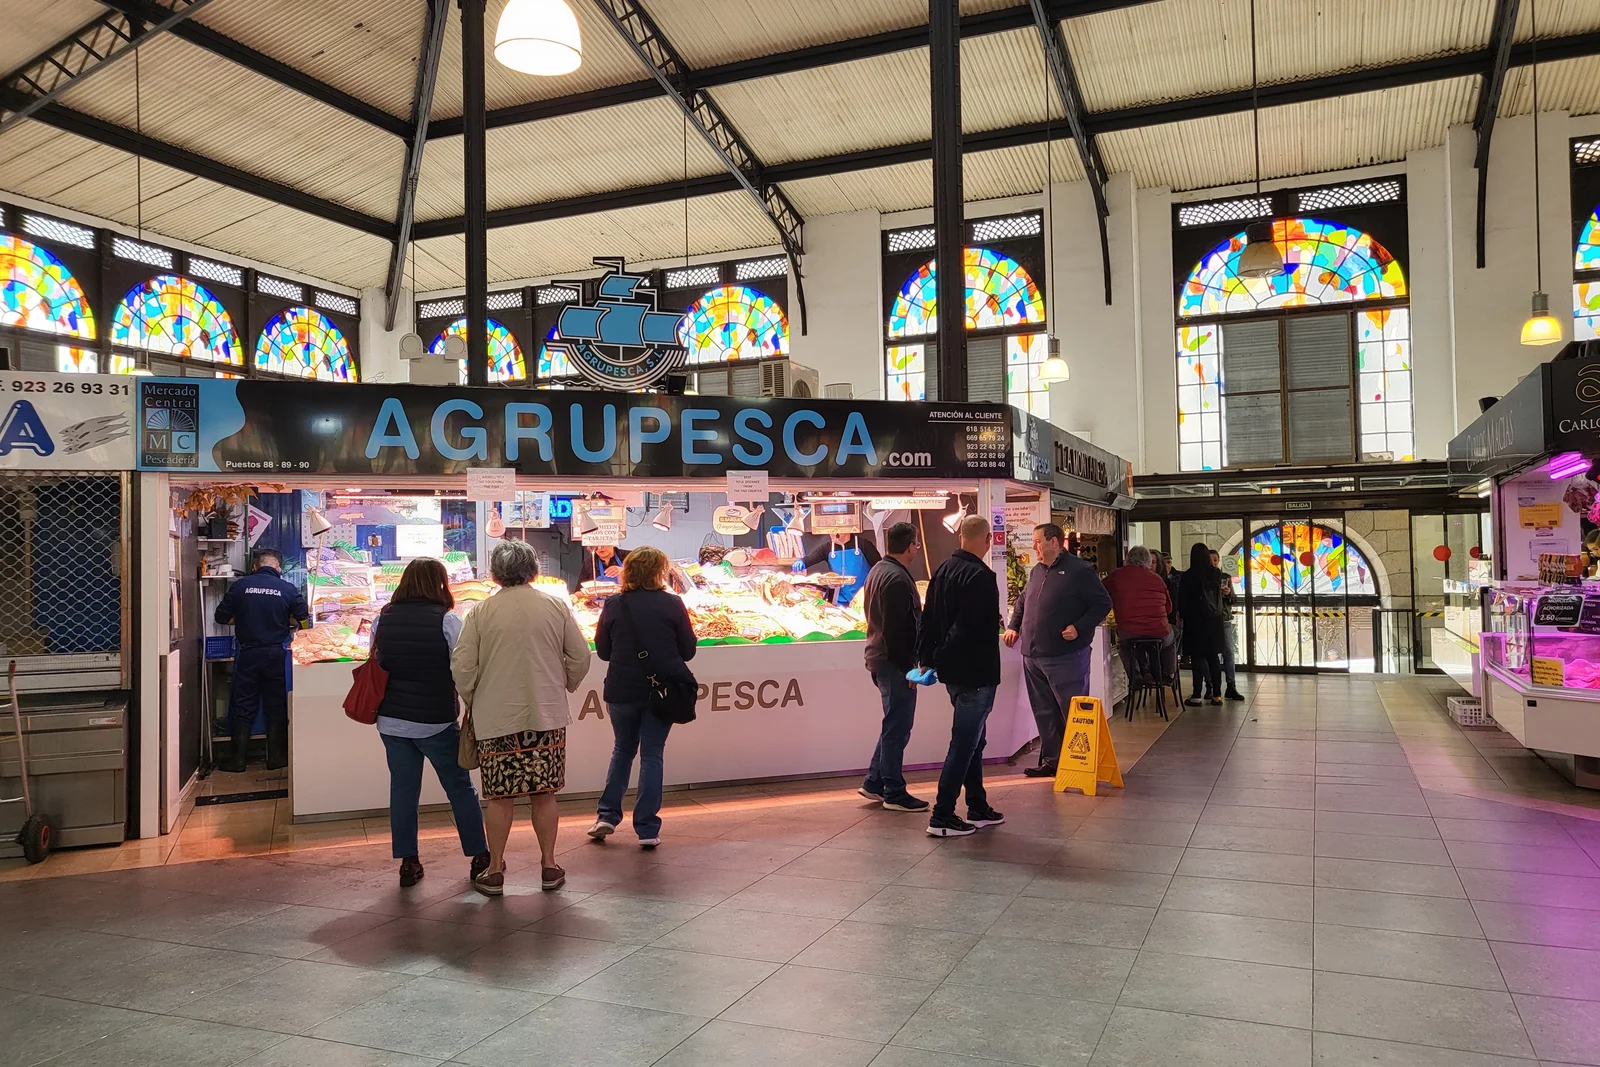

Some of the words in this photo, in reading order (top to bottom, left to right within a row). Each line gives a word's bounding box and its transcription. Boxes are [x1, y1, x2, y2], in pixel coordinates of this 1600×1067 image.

[12, 381, 46, 393] 923
[53, 382, 75, 394] 26
[81, 383, 103, 395] 93
[109, 384, 129, 396] 31
[145, 385, 196, 396] Mercado
[145, 397, 196, 408] Central
[929, 410, 962, 419] ATENCIÓN
[149, 434, 167, 449] M
[177, 434, 190, 450] C
[145, 455, 196, 465] Pescadería
[245, 587, 282, 597] AGRUPESCA
[578, 678, 804, 721] APESCA
[1072, 717, 1094, 725] CAUTION
